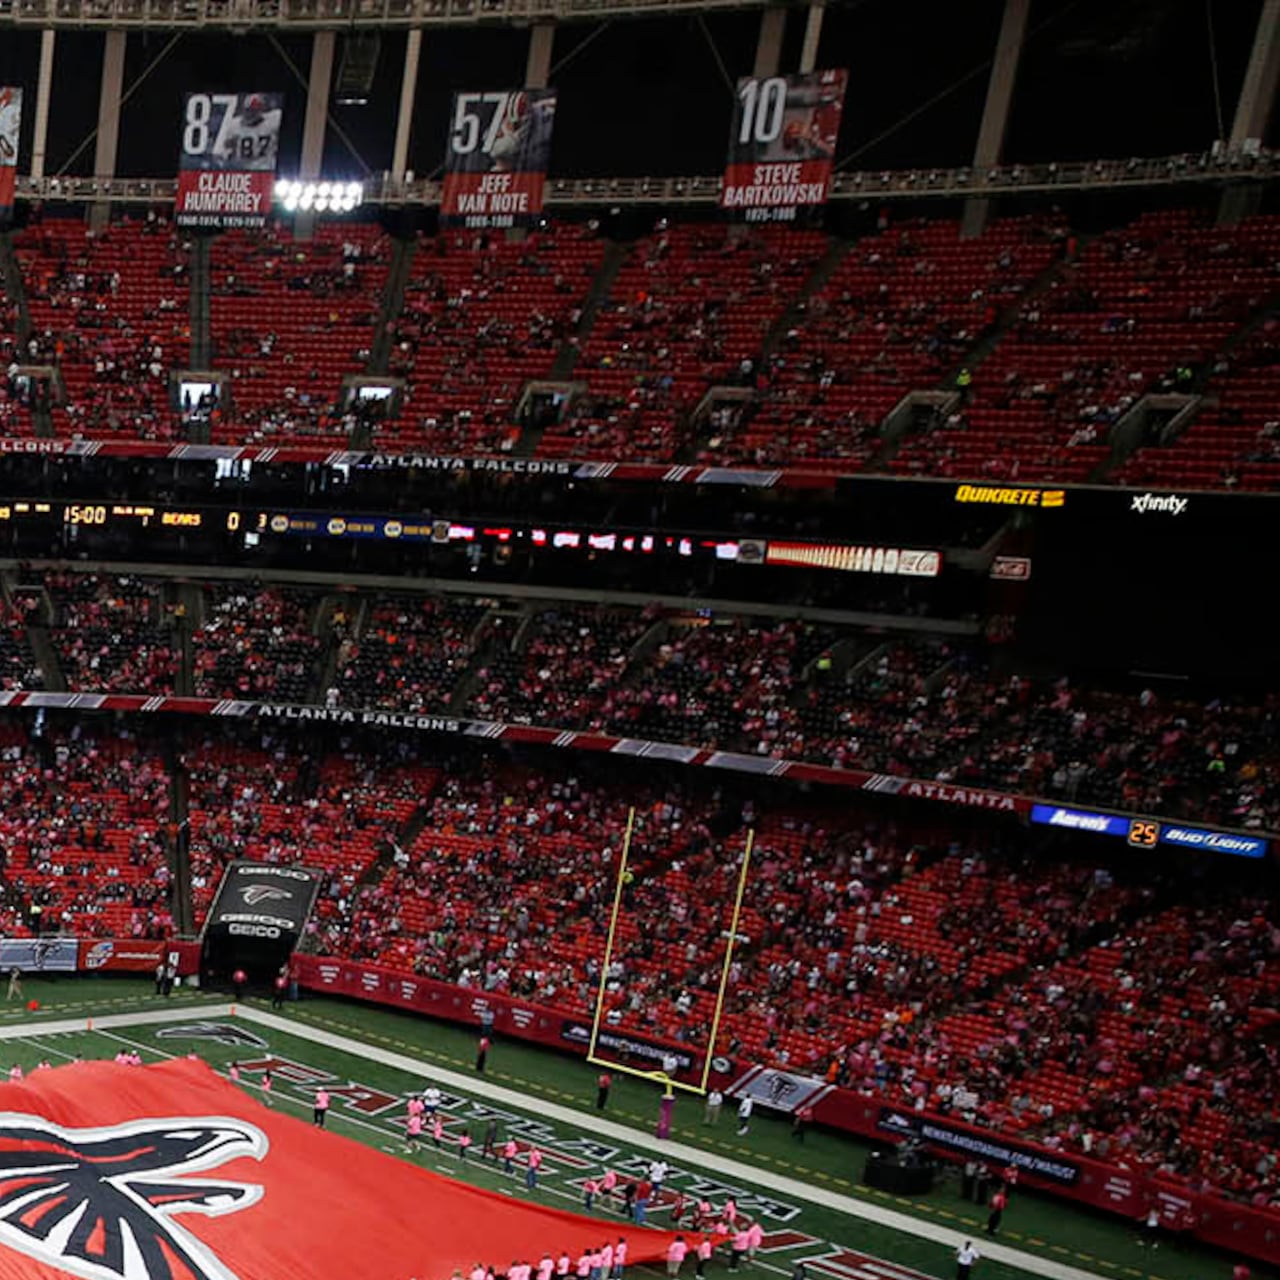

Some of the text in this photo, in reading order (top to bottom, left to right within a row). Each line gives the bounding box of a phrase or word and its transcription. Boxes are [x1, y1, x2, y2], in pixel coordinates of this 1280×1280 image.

[740, 77, 787, 143] 10
[183, 94, 238, 155] 87
[452, 93, 509, 154] 57
[198, 172, 252, 193] CLAUDE
[478, 174, 512, 194] JEFF
[754, 164, 802, 185] STEVE
[184, 191, 263, 214] HUMPHREY
[457, 192, 529, 214] VAN NOTE
[724, 183, 825, 207] BARTKOWSKI
[370, 454, 570, 475] ATLANTA FALCONS
[955, 484, 1039, 506] QUIKRETE
[1131, 493, 1187, 515] xfinity
[63, 505, 106, 525] 15:00
[161, 512, 201, 526] BEARS
[227, 512, 239, 531] 0
[257, 704, 460, 732] ATLANTA FALCONS
[907, 782, 1016, 812] ATLANTA
[1130, 821, 1158, 845] 25
